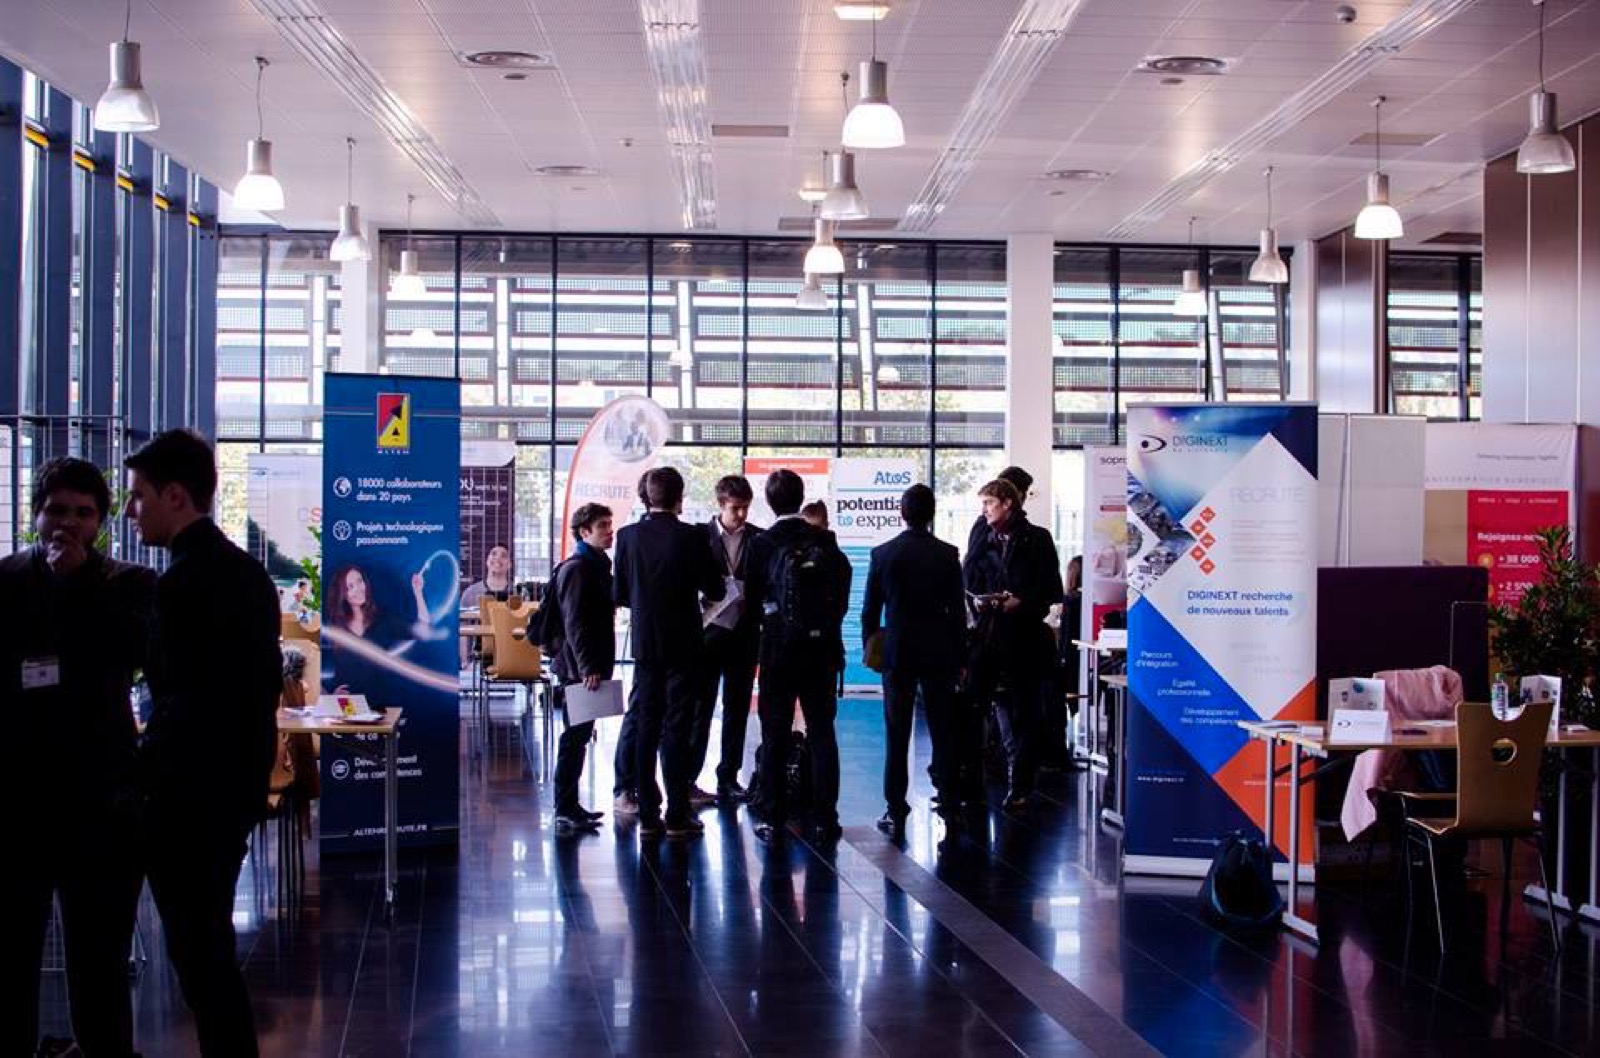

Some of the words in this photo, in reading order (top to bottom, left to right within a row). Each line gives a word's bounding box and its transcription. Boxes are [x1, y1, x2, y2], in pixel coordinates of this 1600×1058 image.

[1172, 435, 1228, 446] DIGINEXT
[357, 478, 384, 489] 18000
[386, 478, 442, 489] collaborateurs
[356, 491, 377, 501] dans
[379, 491, 391, 501] 20
[392, 492, 411, 504] pays
[836, 497, 903, 514] potentia
[356, 521, 384, 534] Projets
[385, 521, 444, 534] technologiques
[855, 514, 903, 530] exper
[356, 536, 409, 547] passionnants
[1187, 590, 1238, 601] DIGINEXT
[1241, 591, 1293, 601] recherche
[1187, 605, 1200, 614] de
[1202, 607, 1251, 615] nouveaux
[1254, 606, 1289, 615] talents
